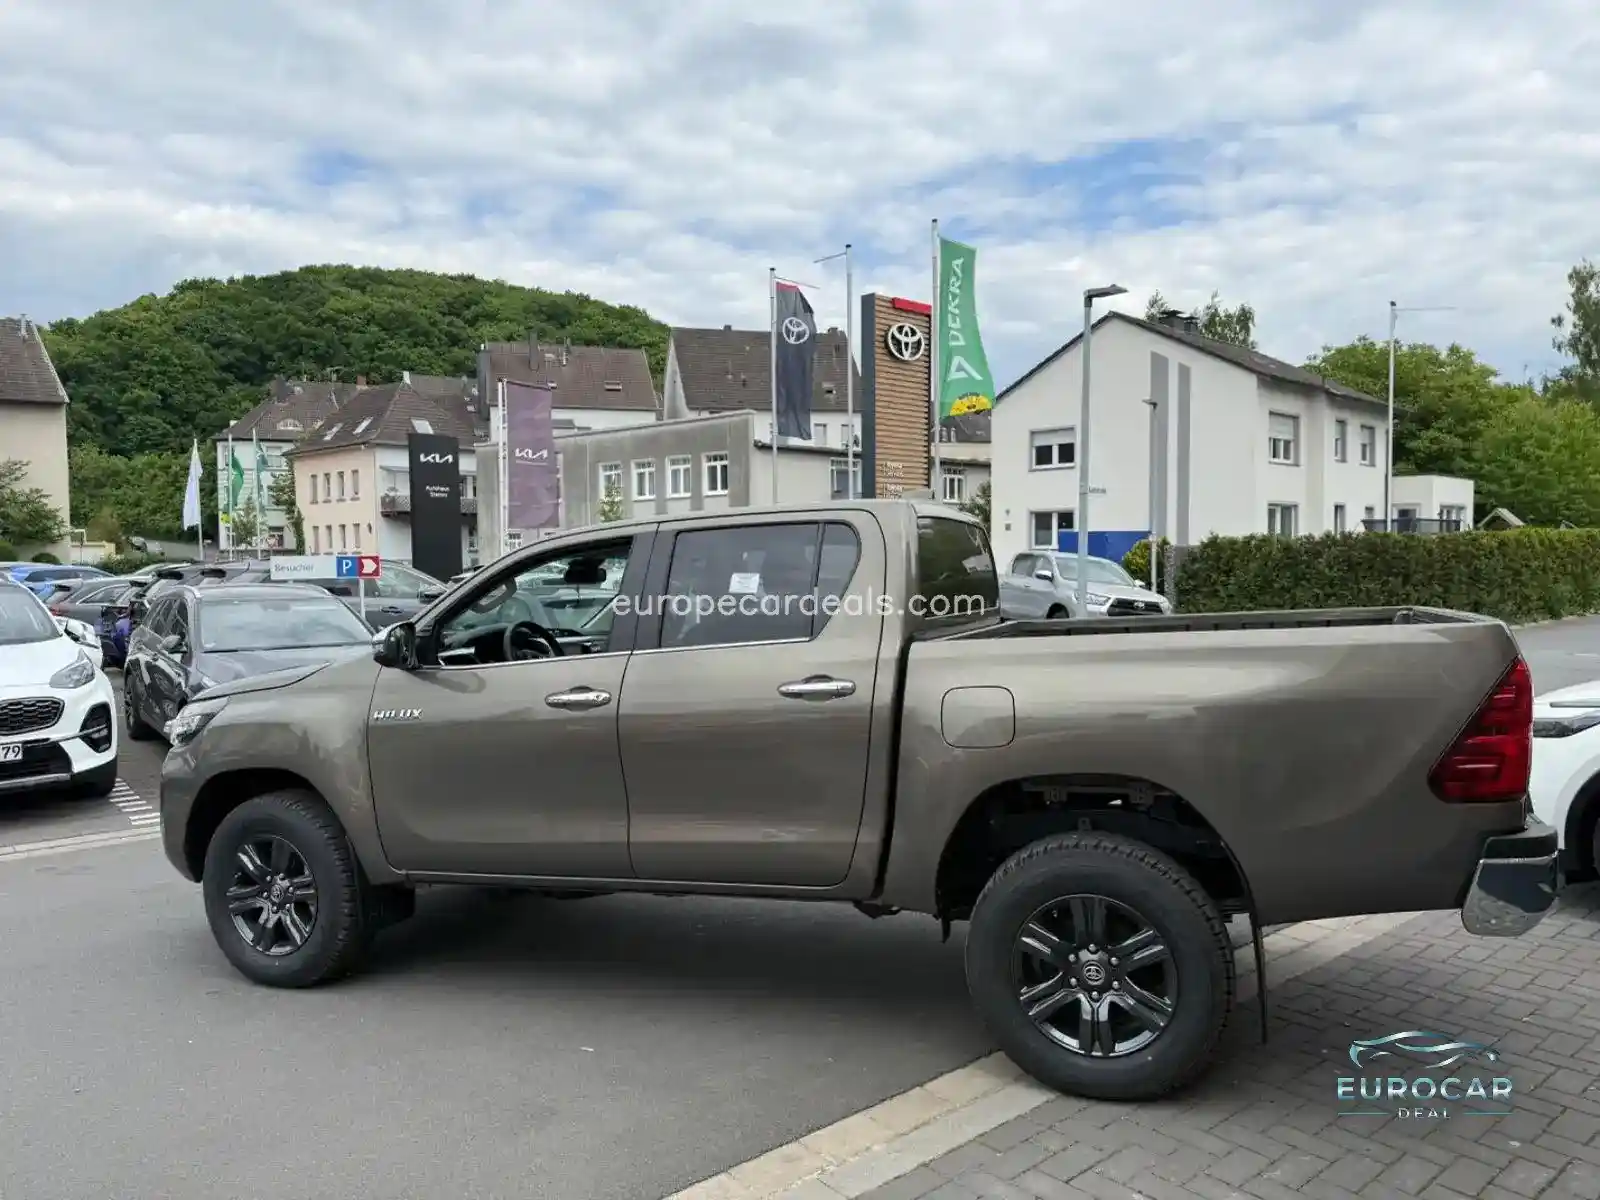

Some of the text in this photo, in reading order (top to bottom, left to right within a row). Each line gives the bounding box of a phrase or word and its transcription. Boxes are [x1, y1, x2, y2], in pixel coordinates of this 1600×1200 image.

[948, 256, 966, 347] DEKRA
[420, 453, 453, 463] KIA
[515, 448, 548, 459] KIA
[342, 559, 353, 574] P
[373, 709, 422, 719] HILUX
[2, 745, 20, 759] 79
